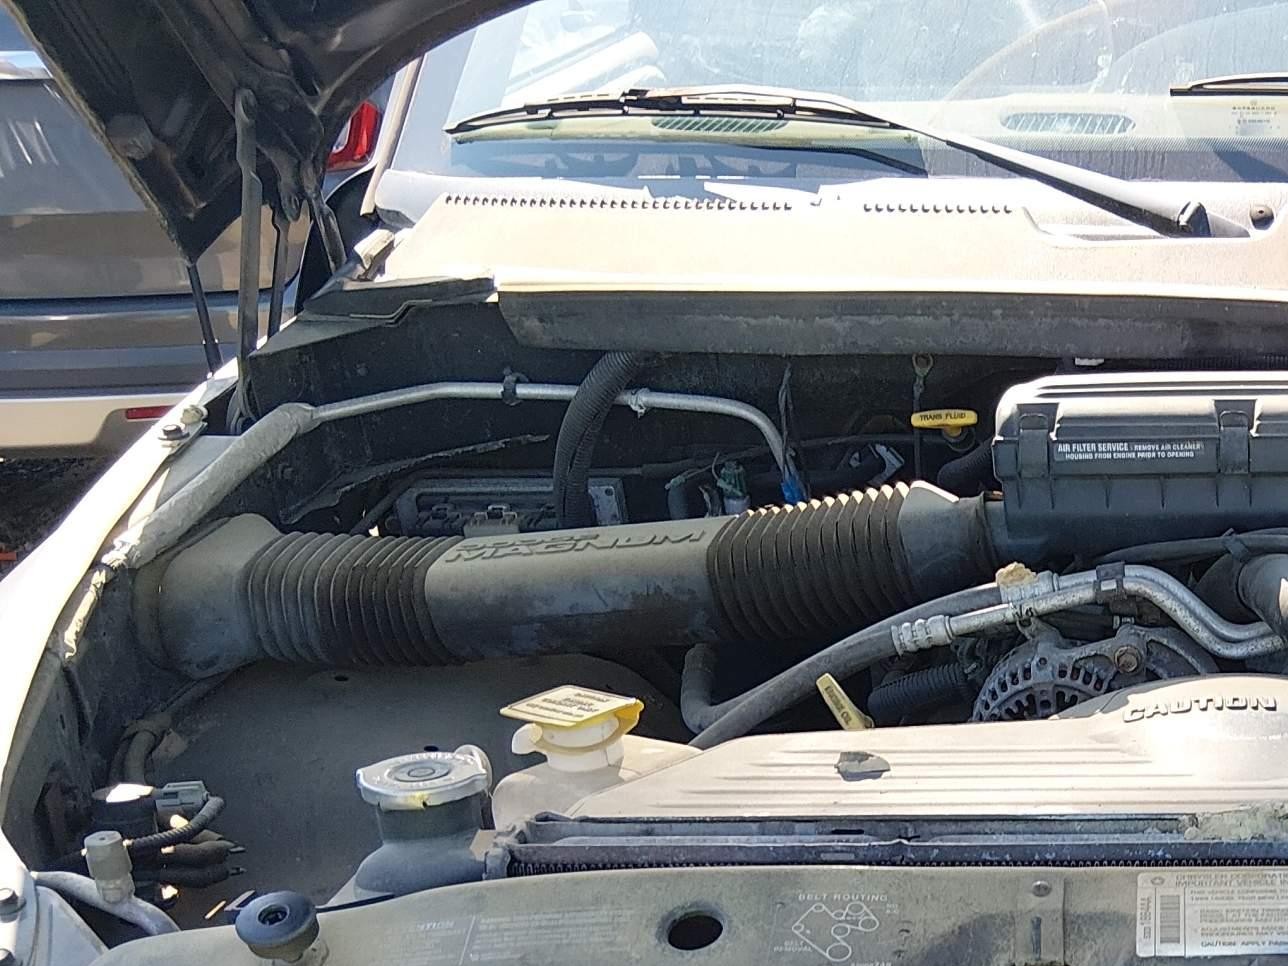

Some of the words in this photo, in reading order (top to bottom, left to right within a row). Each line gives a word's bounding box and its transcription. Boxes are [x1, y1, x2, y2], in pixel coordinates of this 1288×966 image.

[945, 412, 966, 420] FLUID
[1057, 442, 1071, 452] AIR
[1072, 442, 1097, 452] FILTER
[1098, 442, 1129, 452] SERVICE
[445, 530, 705, 563] MAGNUM
[1122, 695, 1278, 723] CAUTION
[798, 893, 829, 901] BELT
[833, 894, 888, 902] ROUTING
